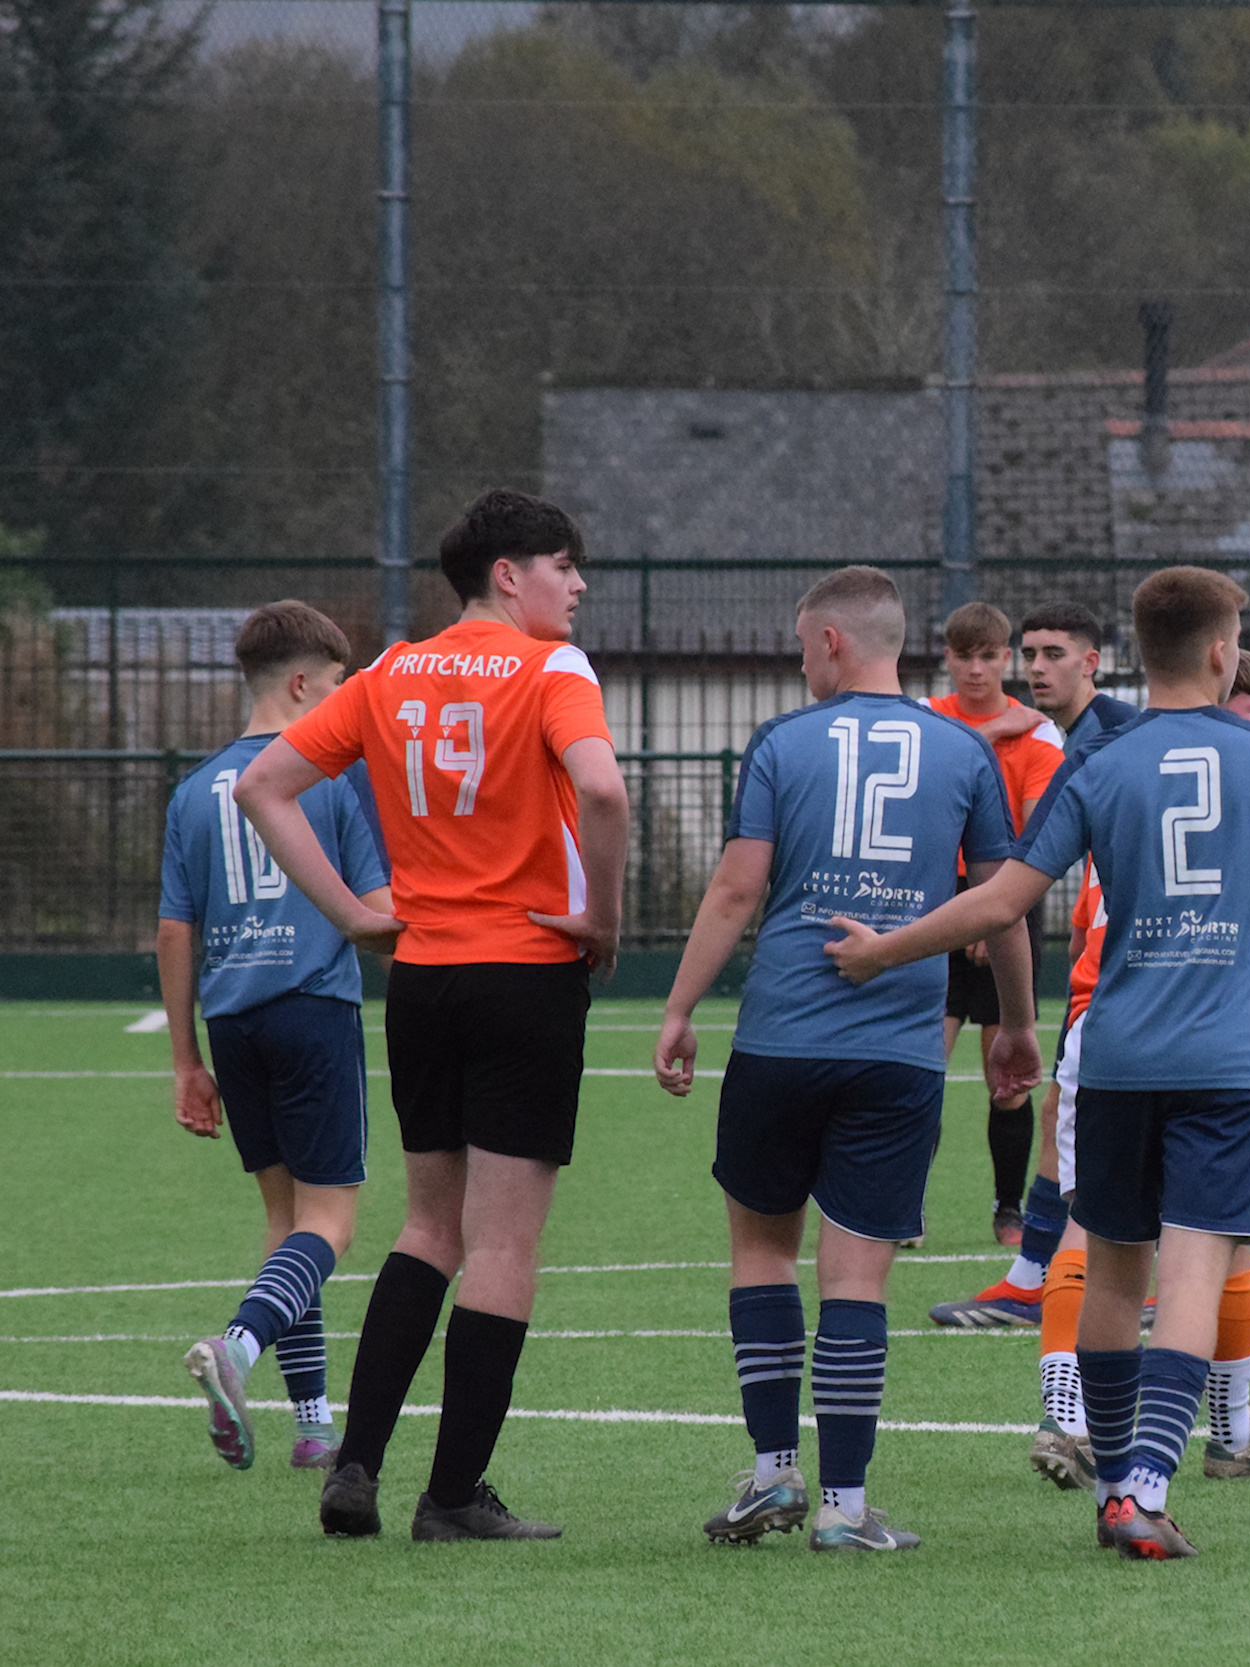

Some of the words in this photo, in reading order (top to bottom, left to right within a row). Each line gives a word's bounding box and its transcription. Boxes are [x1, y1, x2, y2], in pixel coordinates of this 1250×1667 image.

[389, 653, 522, 678] PRITCHARD
[396, 700, 485, 817] 19
[828, 716, 922, 863] 12
[1159, 746, 1222, 896] 2
[812, 871, 851, 883] NEXT
[803, 882, 848, 896] LEVEL
[870, 900, 923, 909] COACHING
[1135, 917, 1173, 927] NEXT
